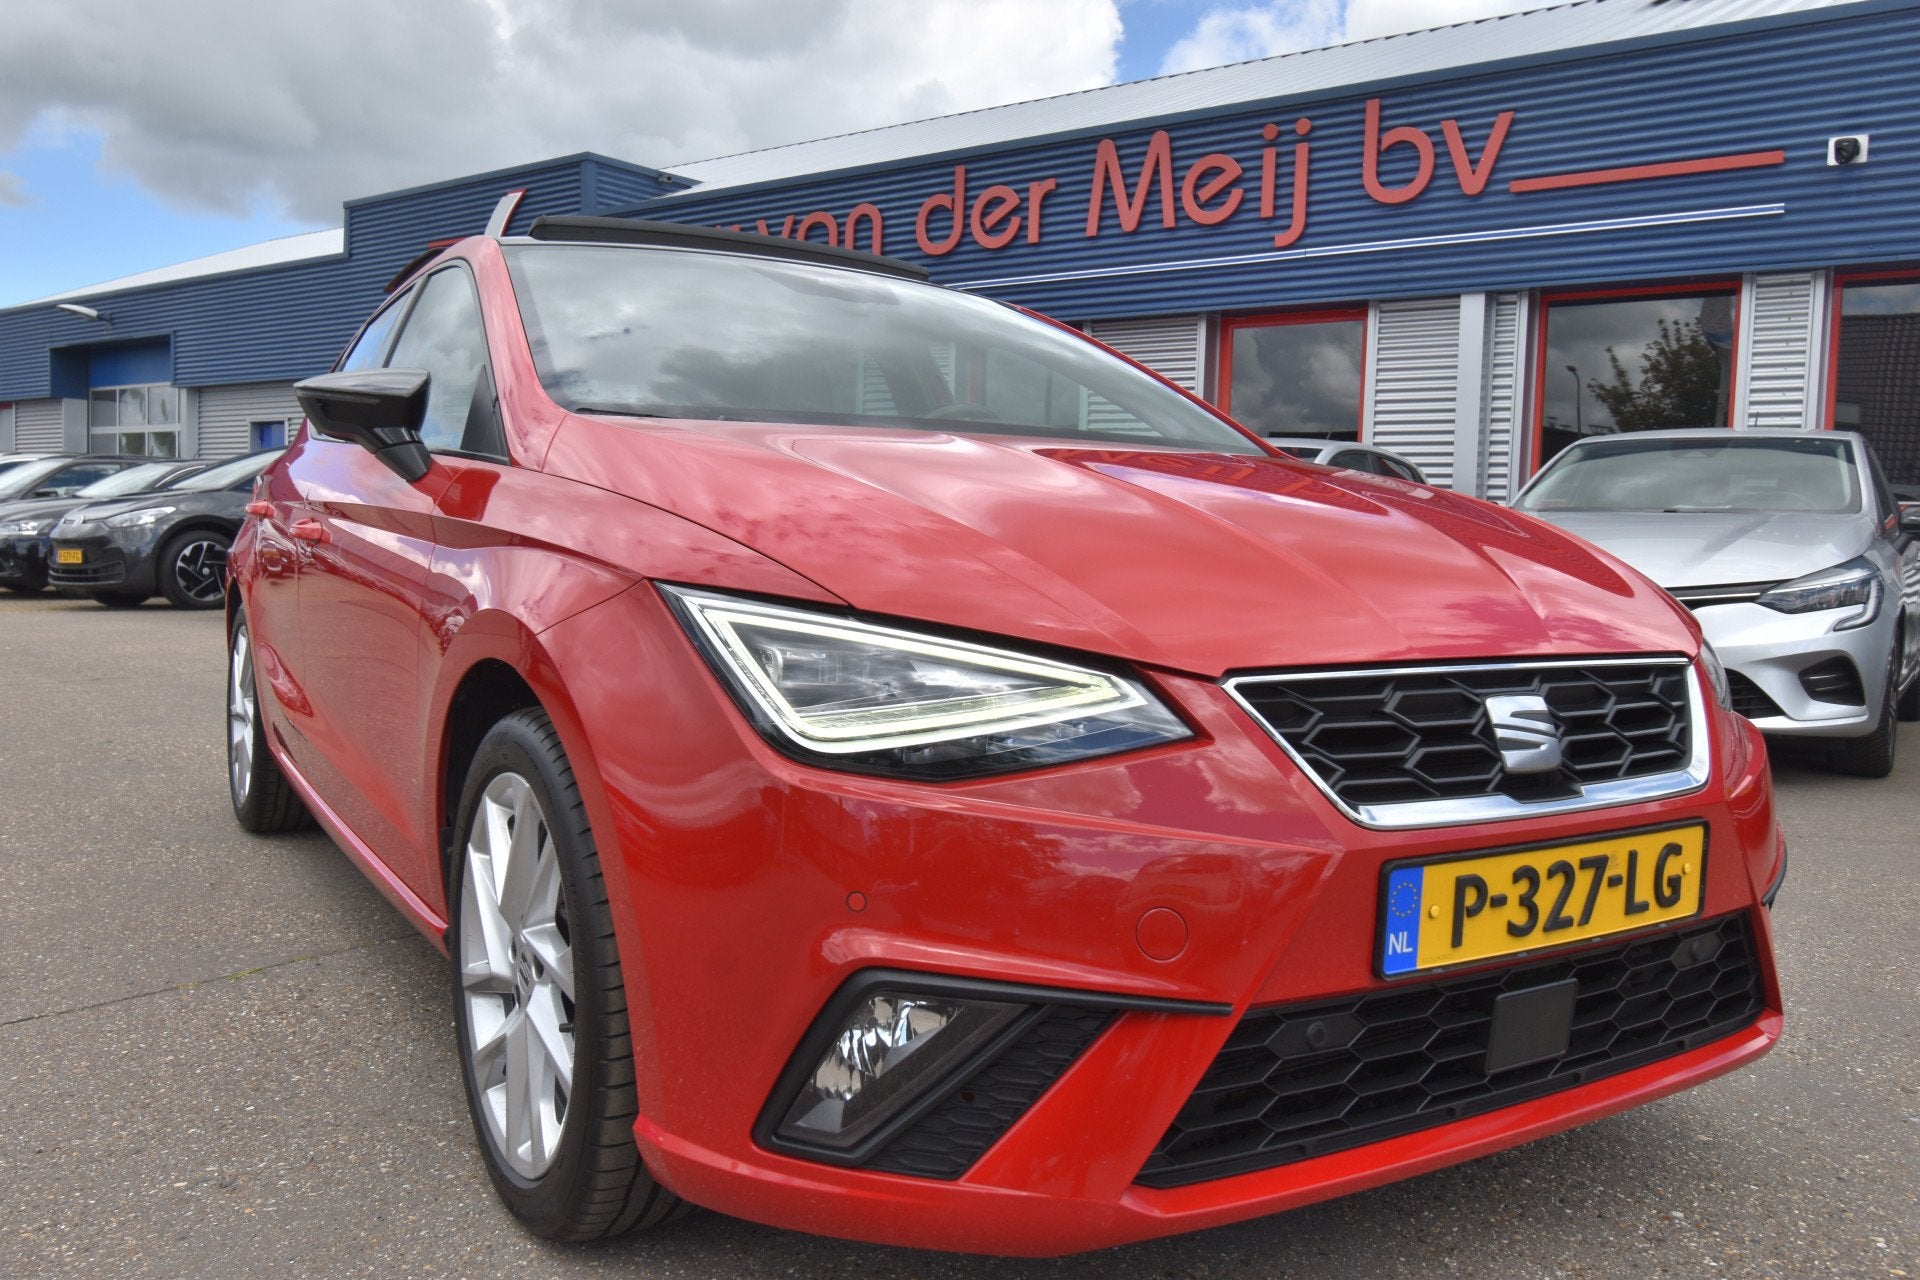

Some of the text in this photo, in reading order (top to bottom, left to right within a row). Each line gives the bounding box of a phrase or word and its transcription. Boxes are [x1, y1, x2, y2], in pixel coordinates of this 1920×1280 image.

[916, 164, 1056, 255] der
[1085, 117, 1312, 248] Meij
[1363, 99, 1514, 204] bv
[1388, 931, 1413, 955] NL
[1451, 842, 1683, 948] P-327-LG
